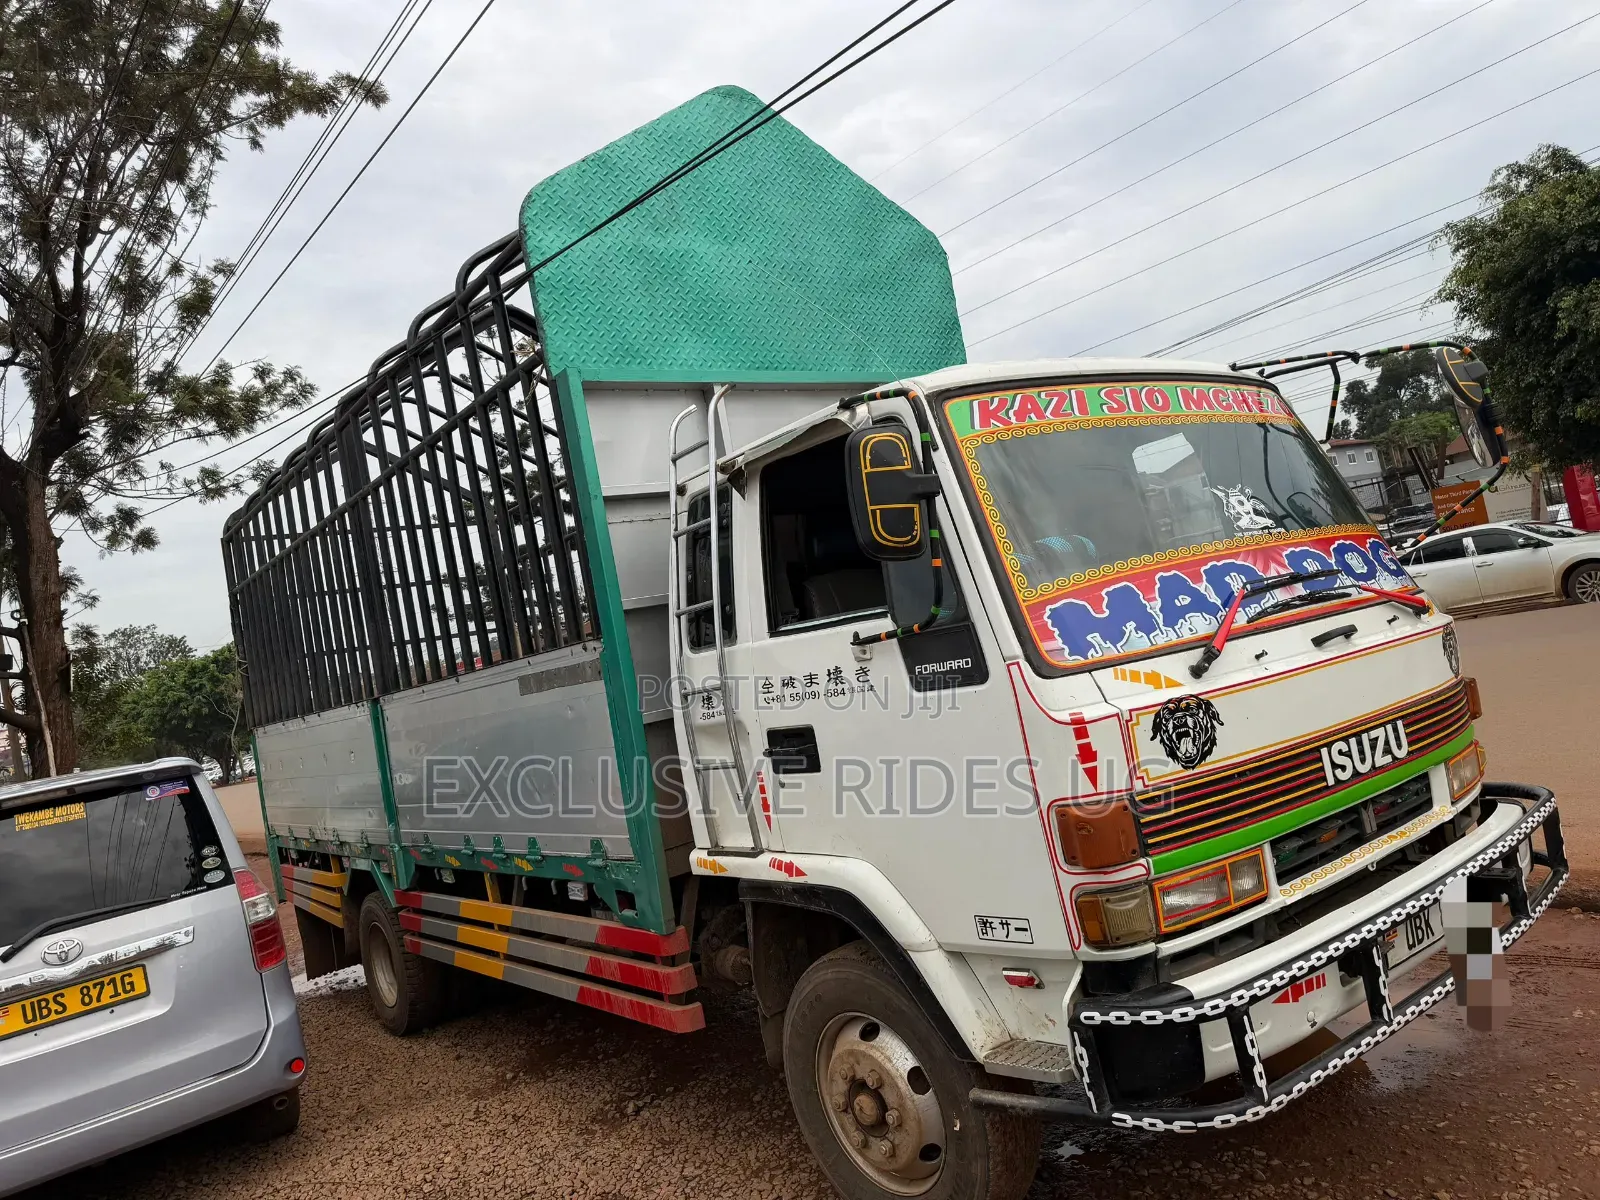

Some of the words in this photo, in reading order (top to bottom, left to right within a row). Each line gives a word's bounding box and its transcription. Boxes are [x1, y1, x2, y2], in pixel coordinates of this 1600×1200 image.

[970, 391, 1090, 430] KAZI
[1099, 385, 1172, 414] SIO
[1044, 559, 1276, 661] MAD
[1282, 538, 1408, 602] DOG
[915, 658, 972, 675] FORWARD
[789, 689, 820, 703] 55(09)
[1320, 719, 1409, 787] ISUZU
[14, 807, 54, 825] TWEKAMBE
[55, 802, 86, 817] MOTORS
[1405, 907, 1435, 951] UBK
[21, 992, 68, 1025] UBS
[79, 972, 136, 1007] 871G
